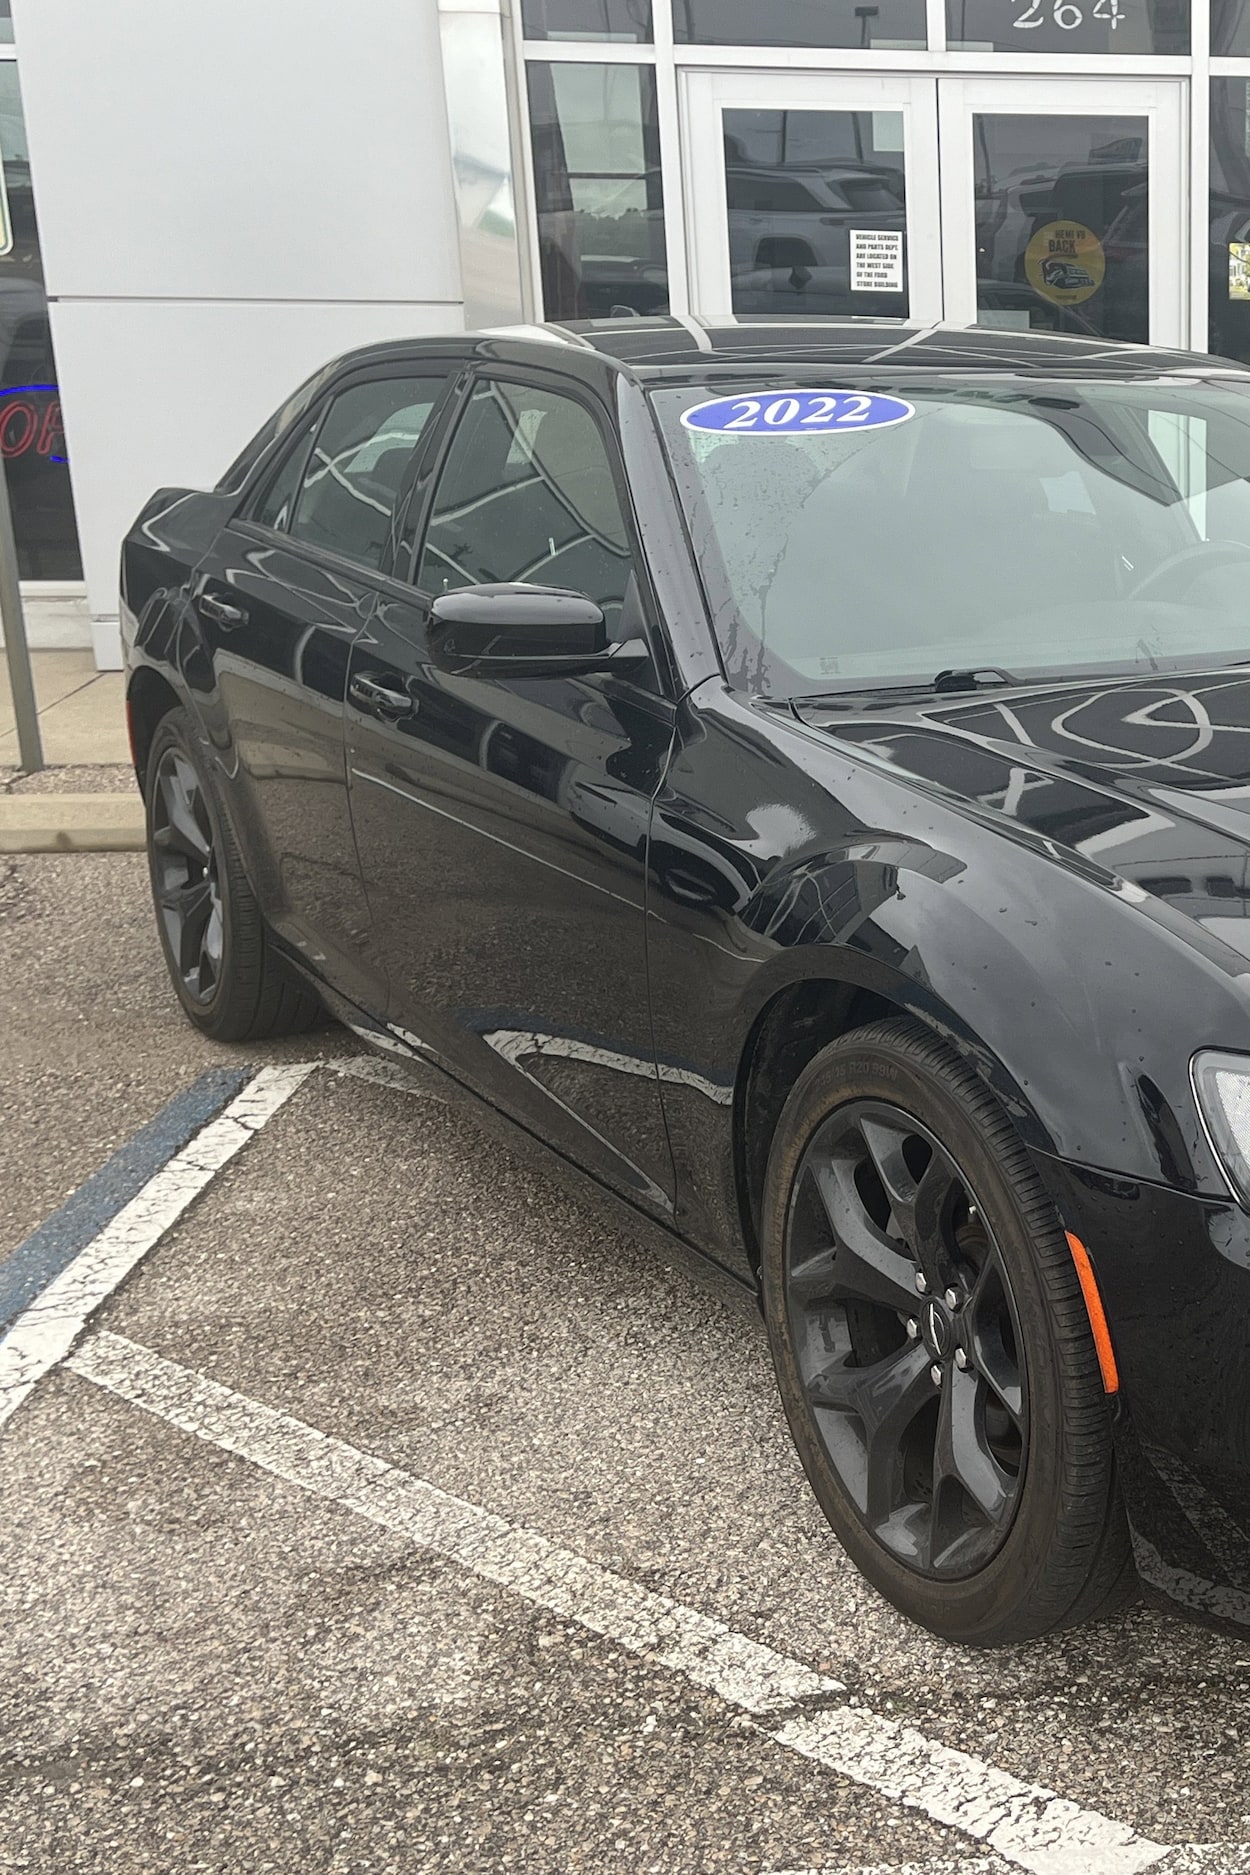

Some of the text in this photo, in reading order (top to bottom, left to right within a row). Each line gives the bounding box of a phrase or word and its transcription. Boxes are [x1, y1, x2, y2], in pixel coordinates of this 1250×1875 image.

[1012, 0, 1126, 30] 264
[1055, 230, 1074, 239] HEMI
[1048, 239, 1076, 253] BACK
[723, 396, 873, 429] 2022
